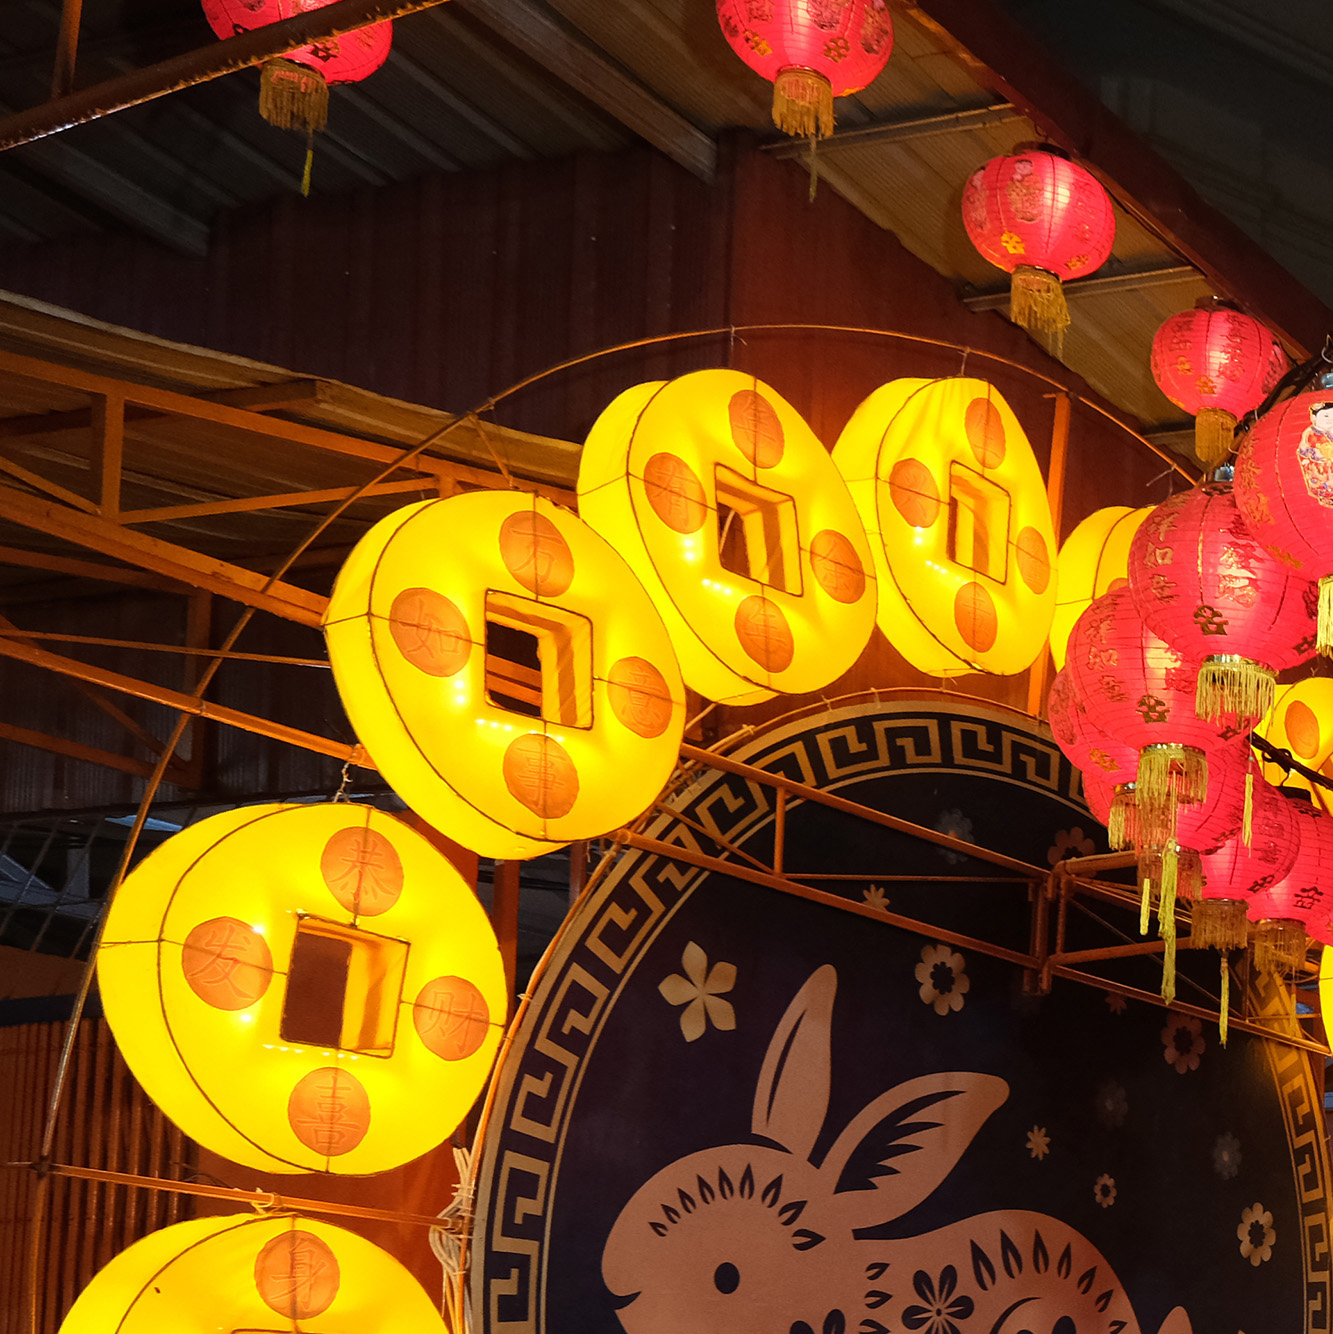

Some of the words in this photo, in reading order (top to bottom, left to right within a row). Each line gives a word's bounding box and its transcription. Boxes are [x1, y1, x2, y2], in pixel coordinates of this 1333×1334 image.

[509, 526, 555, 582] 万
[402, 596, 461, 659] 如
[330, 837, 396, 901] 恭
[190, 924, 257, 1002] 发
[420, 989, 485, 1057] 财
[296, 1075, 361, 1150] 喜
[271, 1236, 326, 1312] 身
